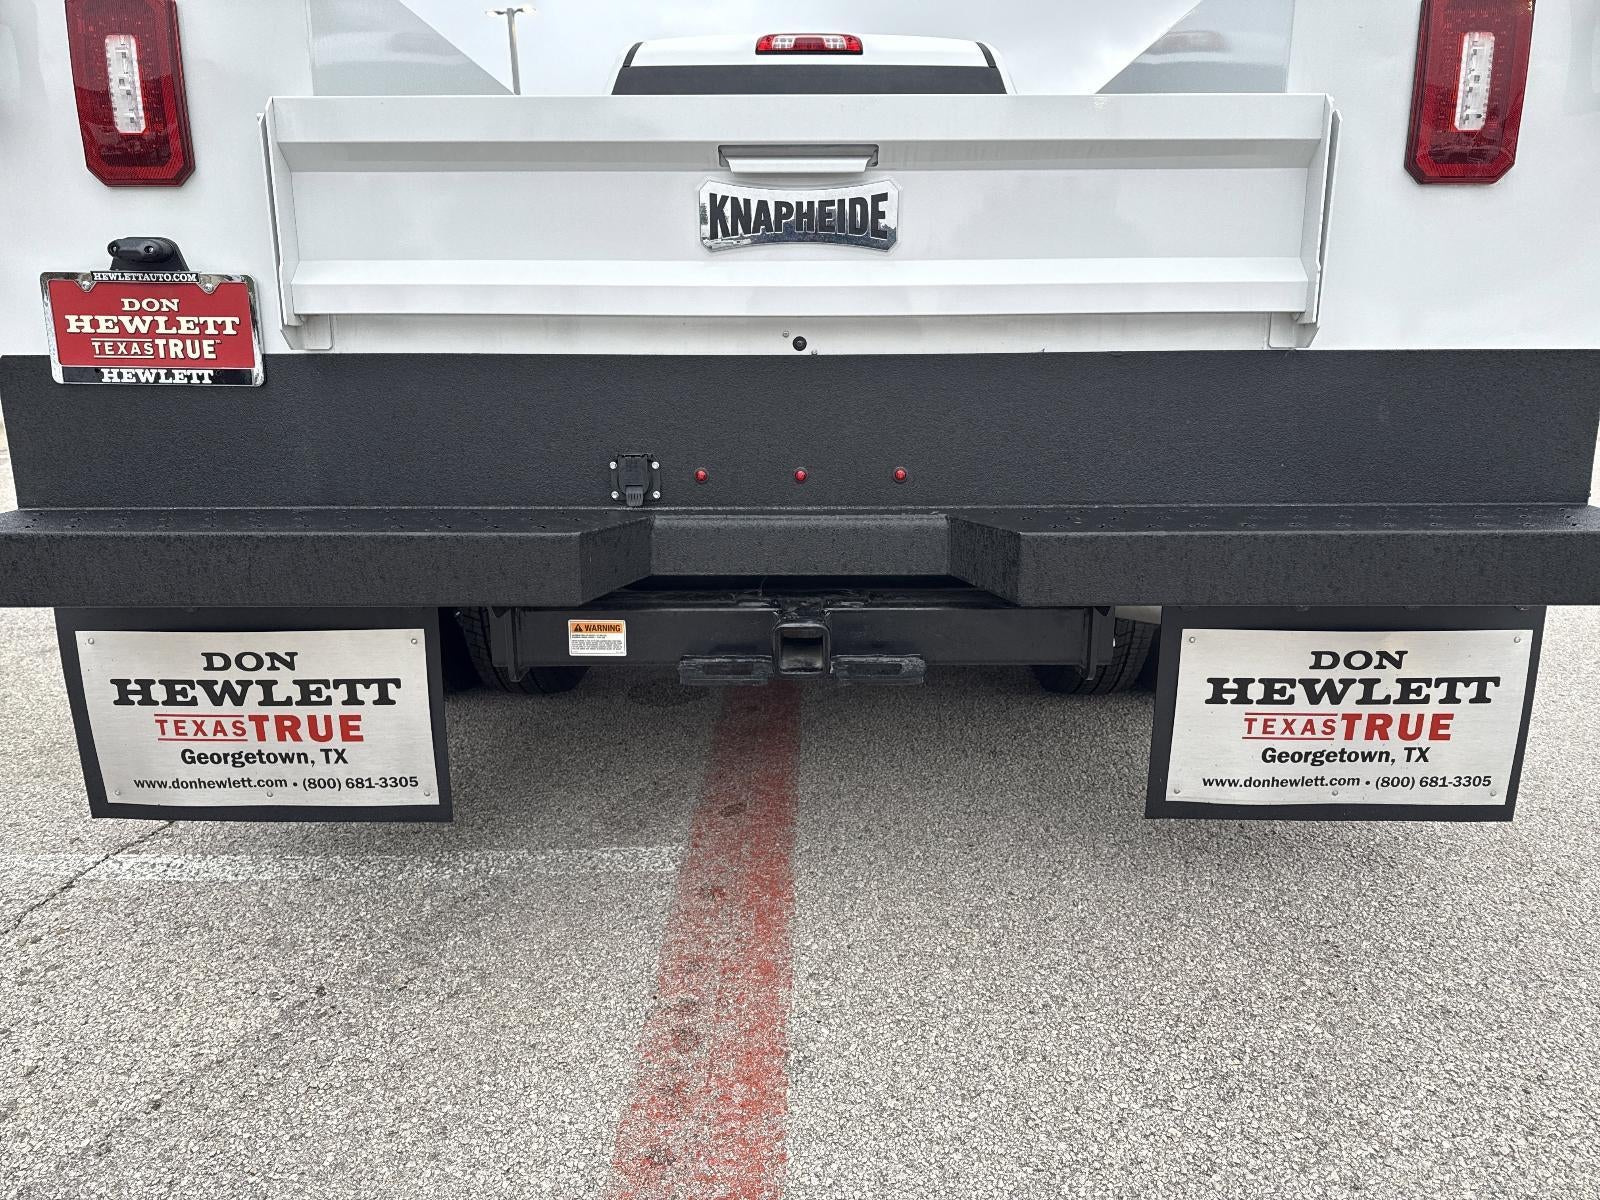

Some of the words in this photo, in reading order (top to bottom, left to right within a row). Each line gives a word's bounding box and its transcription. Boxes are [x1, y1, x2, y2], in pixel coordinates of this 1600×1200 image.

[709, 192, 889, 240] KNAPHEIDE
[93, 272, 198, 282] HEWLETTAUTO.COM
[120, 298, 180, 312] DON
[64, 314, 240, 335] HEWLETT
[101, 368, 214, 384] HEWLETT
[584, 624, 621, 632] WARNING
[201, 651, 299, 672] DON
[1307, 649, 1409, 671] DON
[109, 677, 402, 707] HEWLETT
[1203, 676, 1501, 706] HEWLETT
[180, 747, 316, 768] Georgetown,
[322, 747, 349, 766] TX
[1260, 746, 1397, 767] Georgetown,
[1402, 746, 1431, 764] TX
[133, 775, 289, 791] www.donhewlett.com
[301, 776, 343, 793] (800)
[344, 774, 420, 791] 681-3305
[1201, 773, 1362, 790] www.donhewlett.com
[1374, 774, 1416, 790] (800)
[1418, 773, 1493, 790] 681-3305
